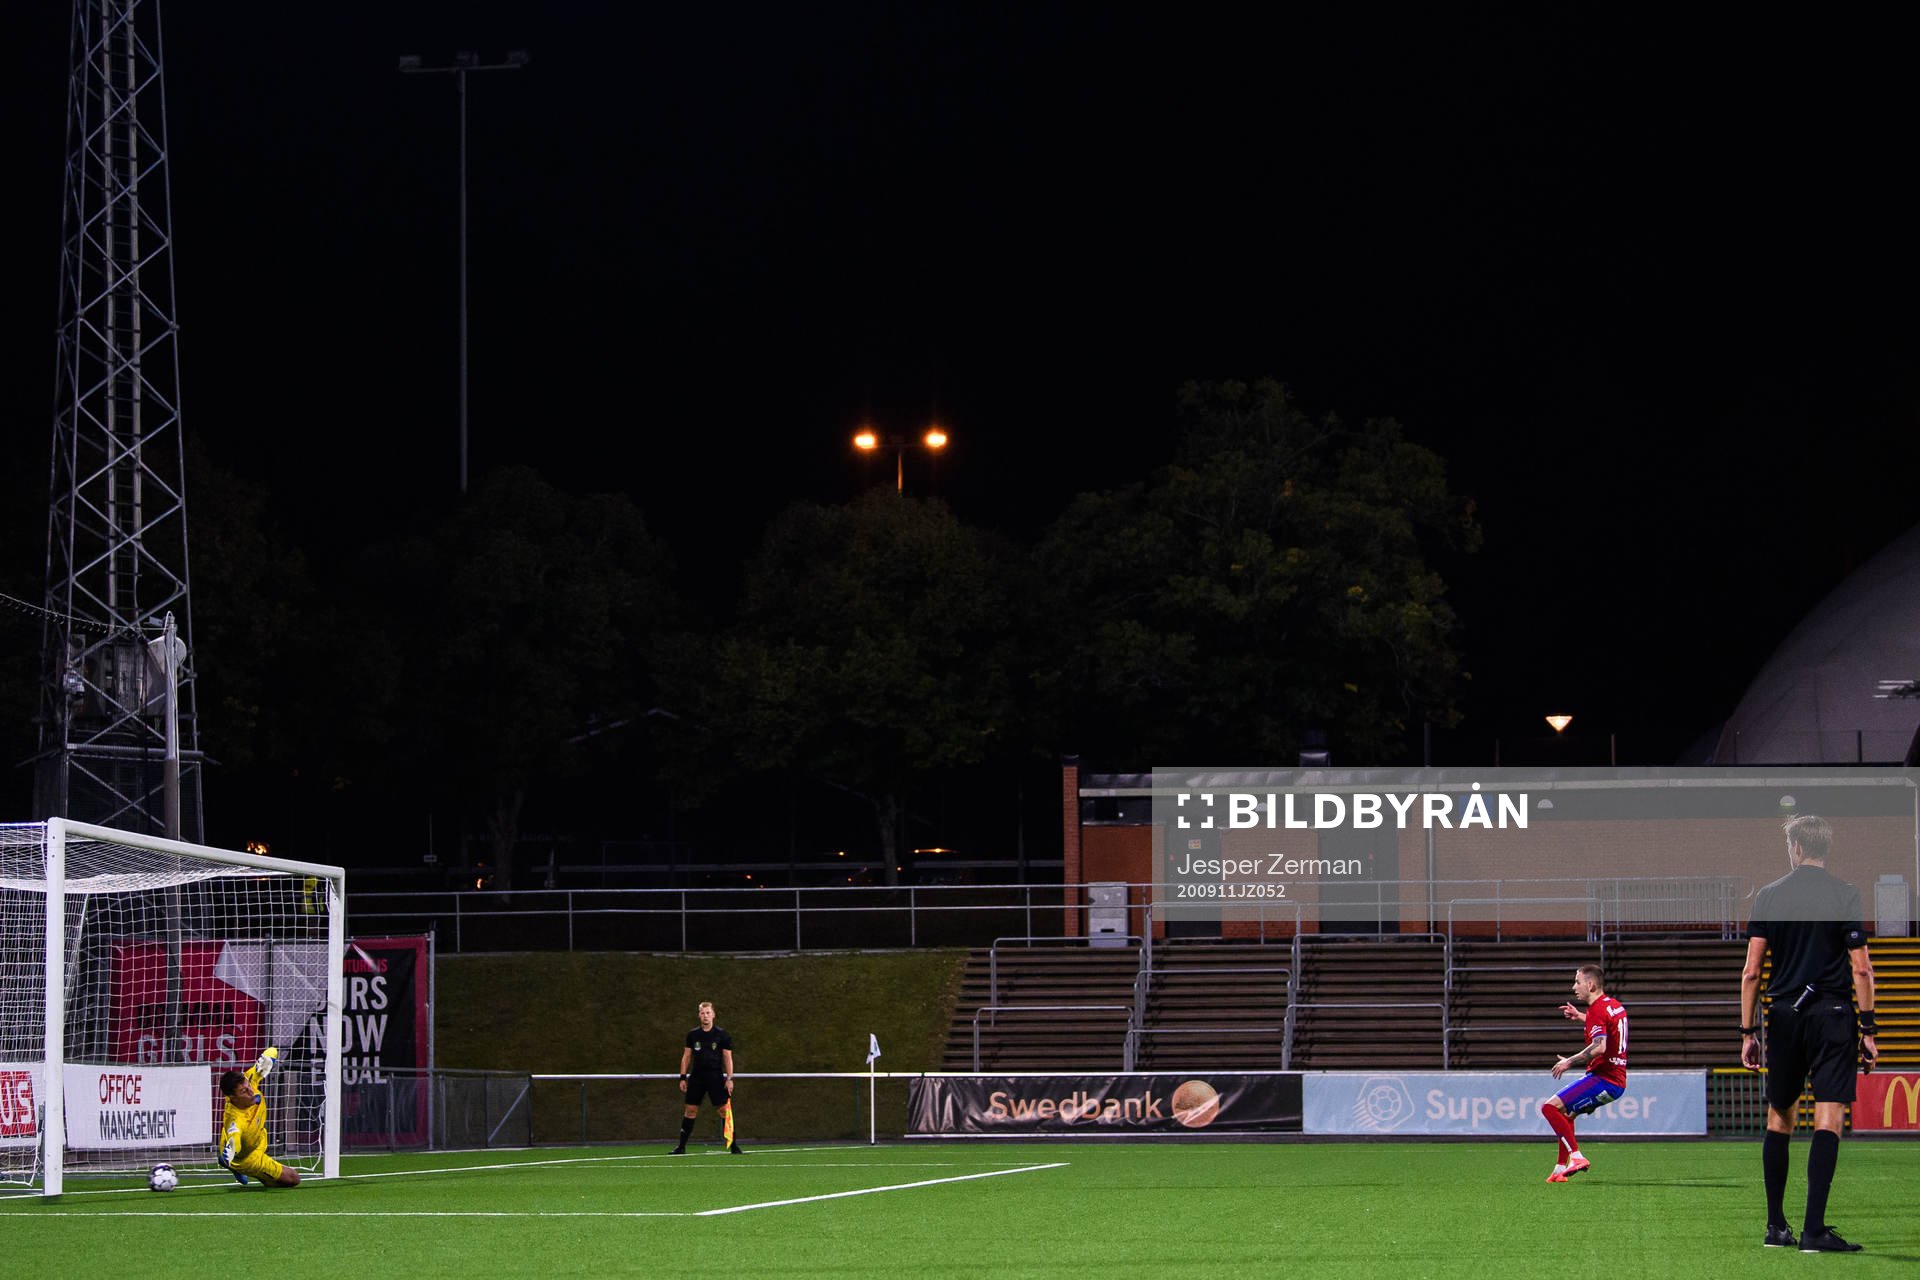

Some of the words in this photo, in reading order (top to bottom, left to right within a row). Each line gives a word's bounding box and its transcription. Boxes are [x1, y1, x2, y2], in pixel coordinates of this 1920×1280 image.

[311, 1056, 388, 1086] EUAL
[99, 1074, 142, 1105] OFFICE
[989, 1091, 1163, 1120] Swedbank
[100, 1109, 177, 1140] MANAGEMENT
